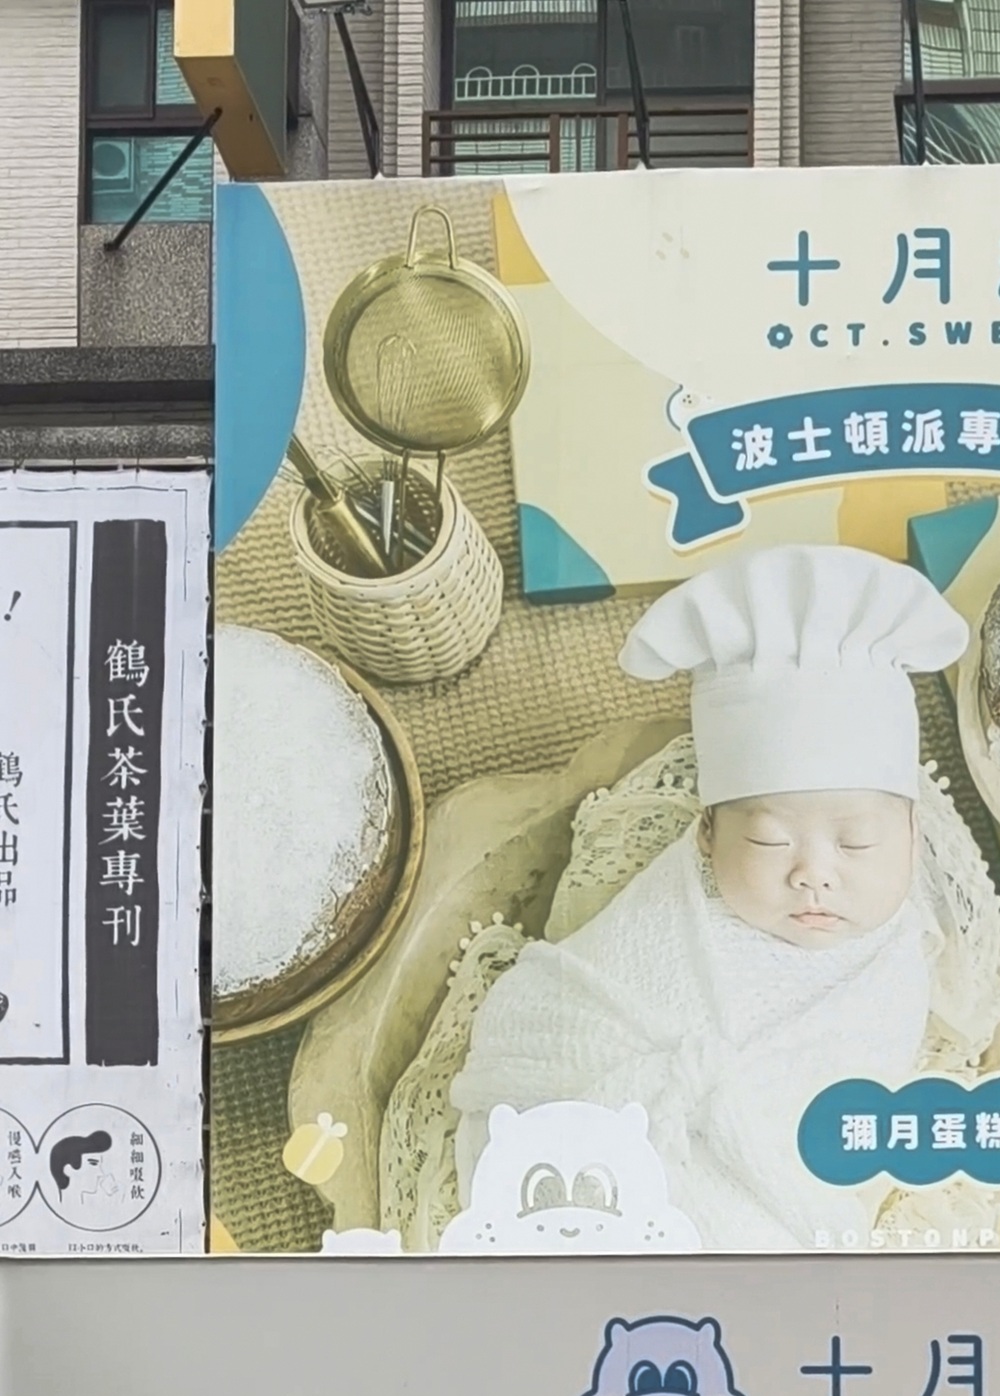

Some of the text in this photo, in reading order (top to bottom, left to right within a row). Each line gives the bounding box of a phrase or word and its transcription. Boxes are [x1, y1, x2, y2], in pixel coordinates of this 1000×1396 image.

[98, 638, 150, 947] 鶴氏茶葉專刊
